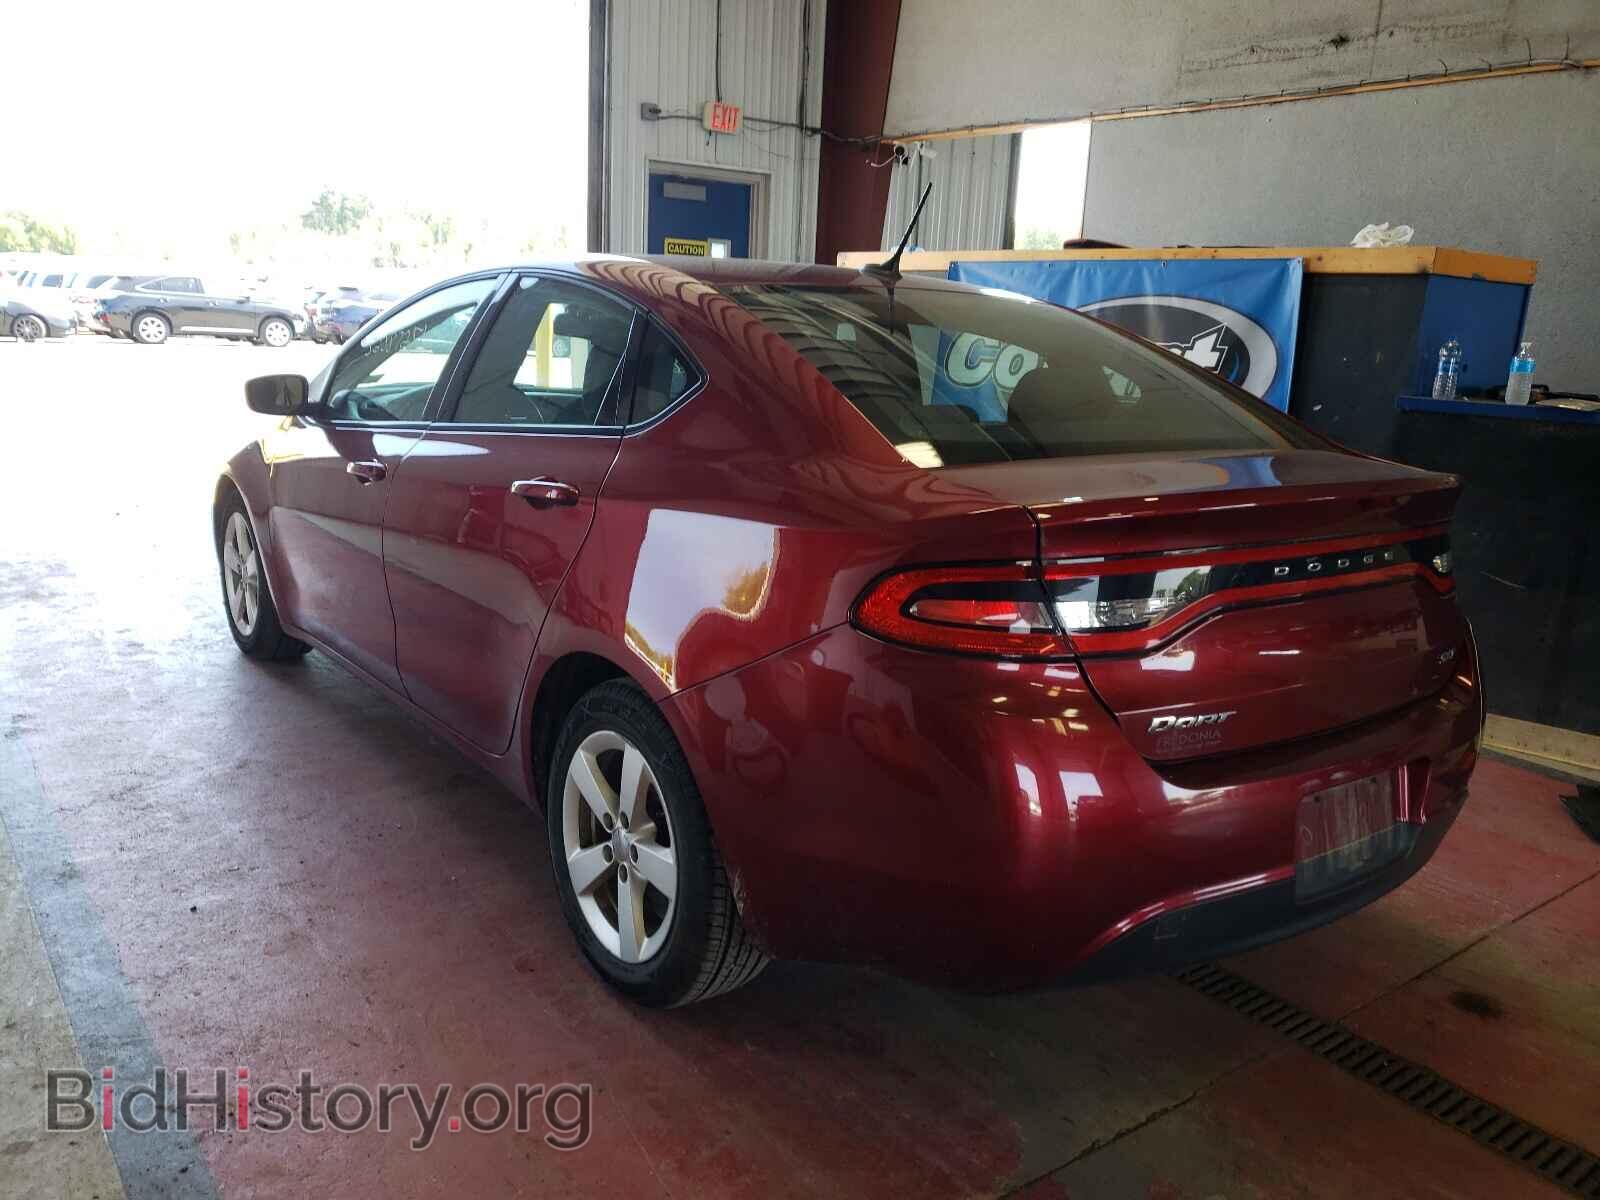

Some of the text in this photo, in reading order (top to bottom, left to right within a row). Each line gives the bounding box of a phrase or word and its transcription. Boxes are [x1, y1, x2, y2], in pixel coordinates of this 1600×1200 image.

[711, 104, 739, 131] EXIT
[667, 242, 704, 255] CAUTION
[1274, 552, 1393, 576] DODGE
